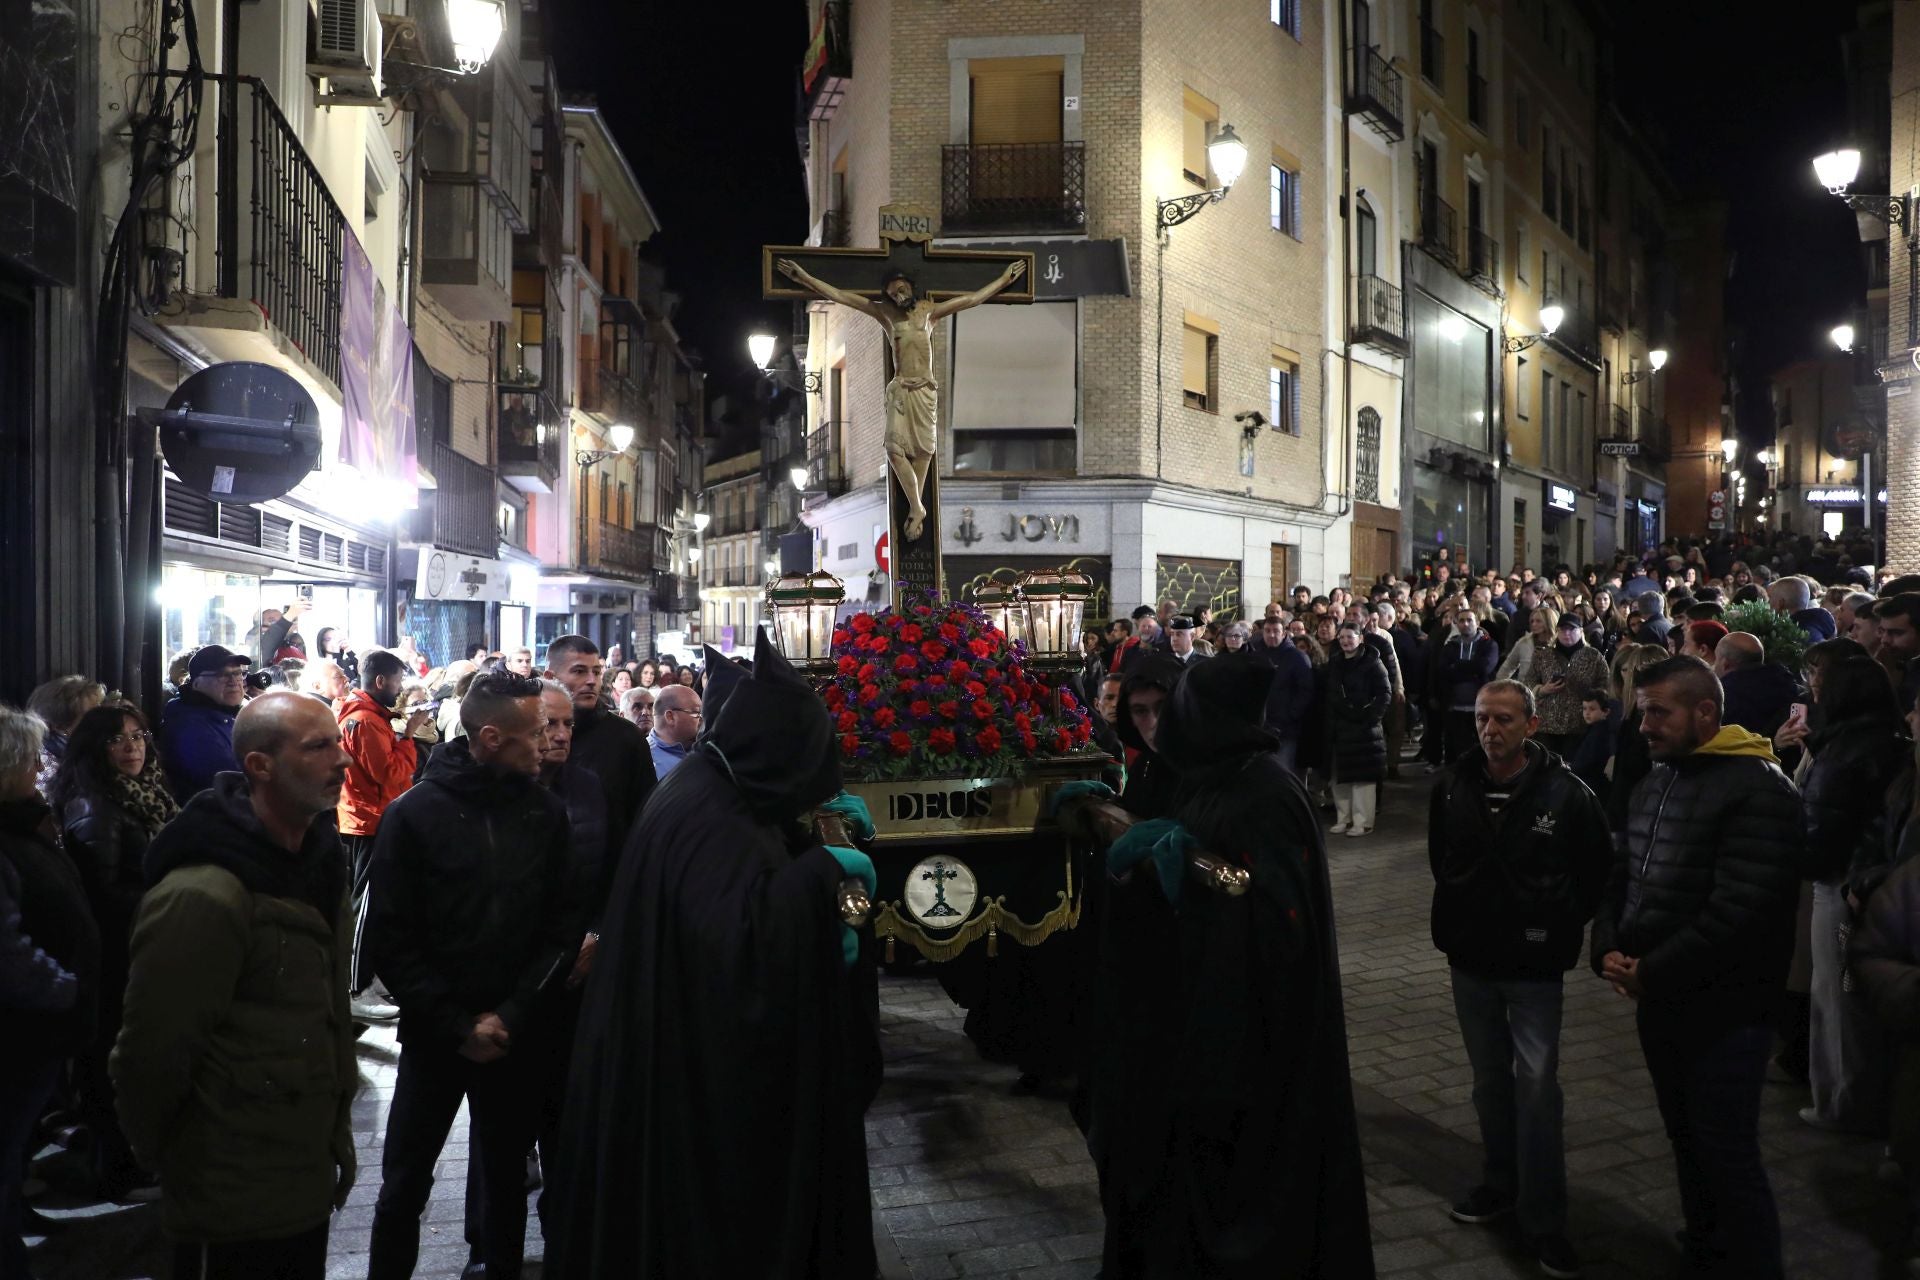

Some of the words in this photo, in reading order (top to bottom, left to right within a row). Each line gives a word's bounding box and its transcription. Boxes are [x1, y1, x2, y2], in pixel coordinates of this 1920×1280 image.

[1603, 445, 1636, 454] OPTICA
[1001, 511, 1080, 543] JOVI
[889, 789, 993, 821] DEUS
